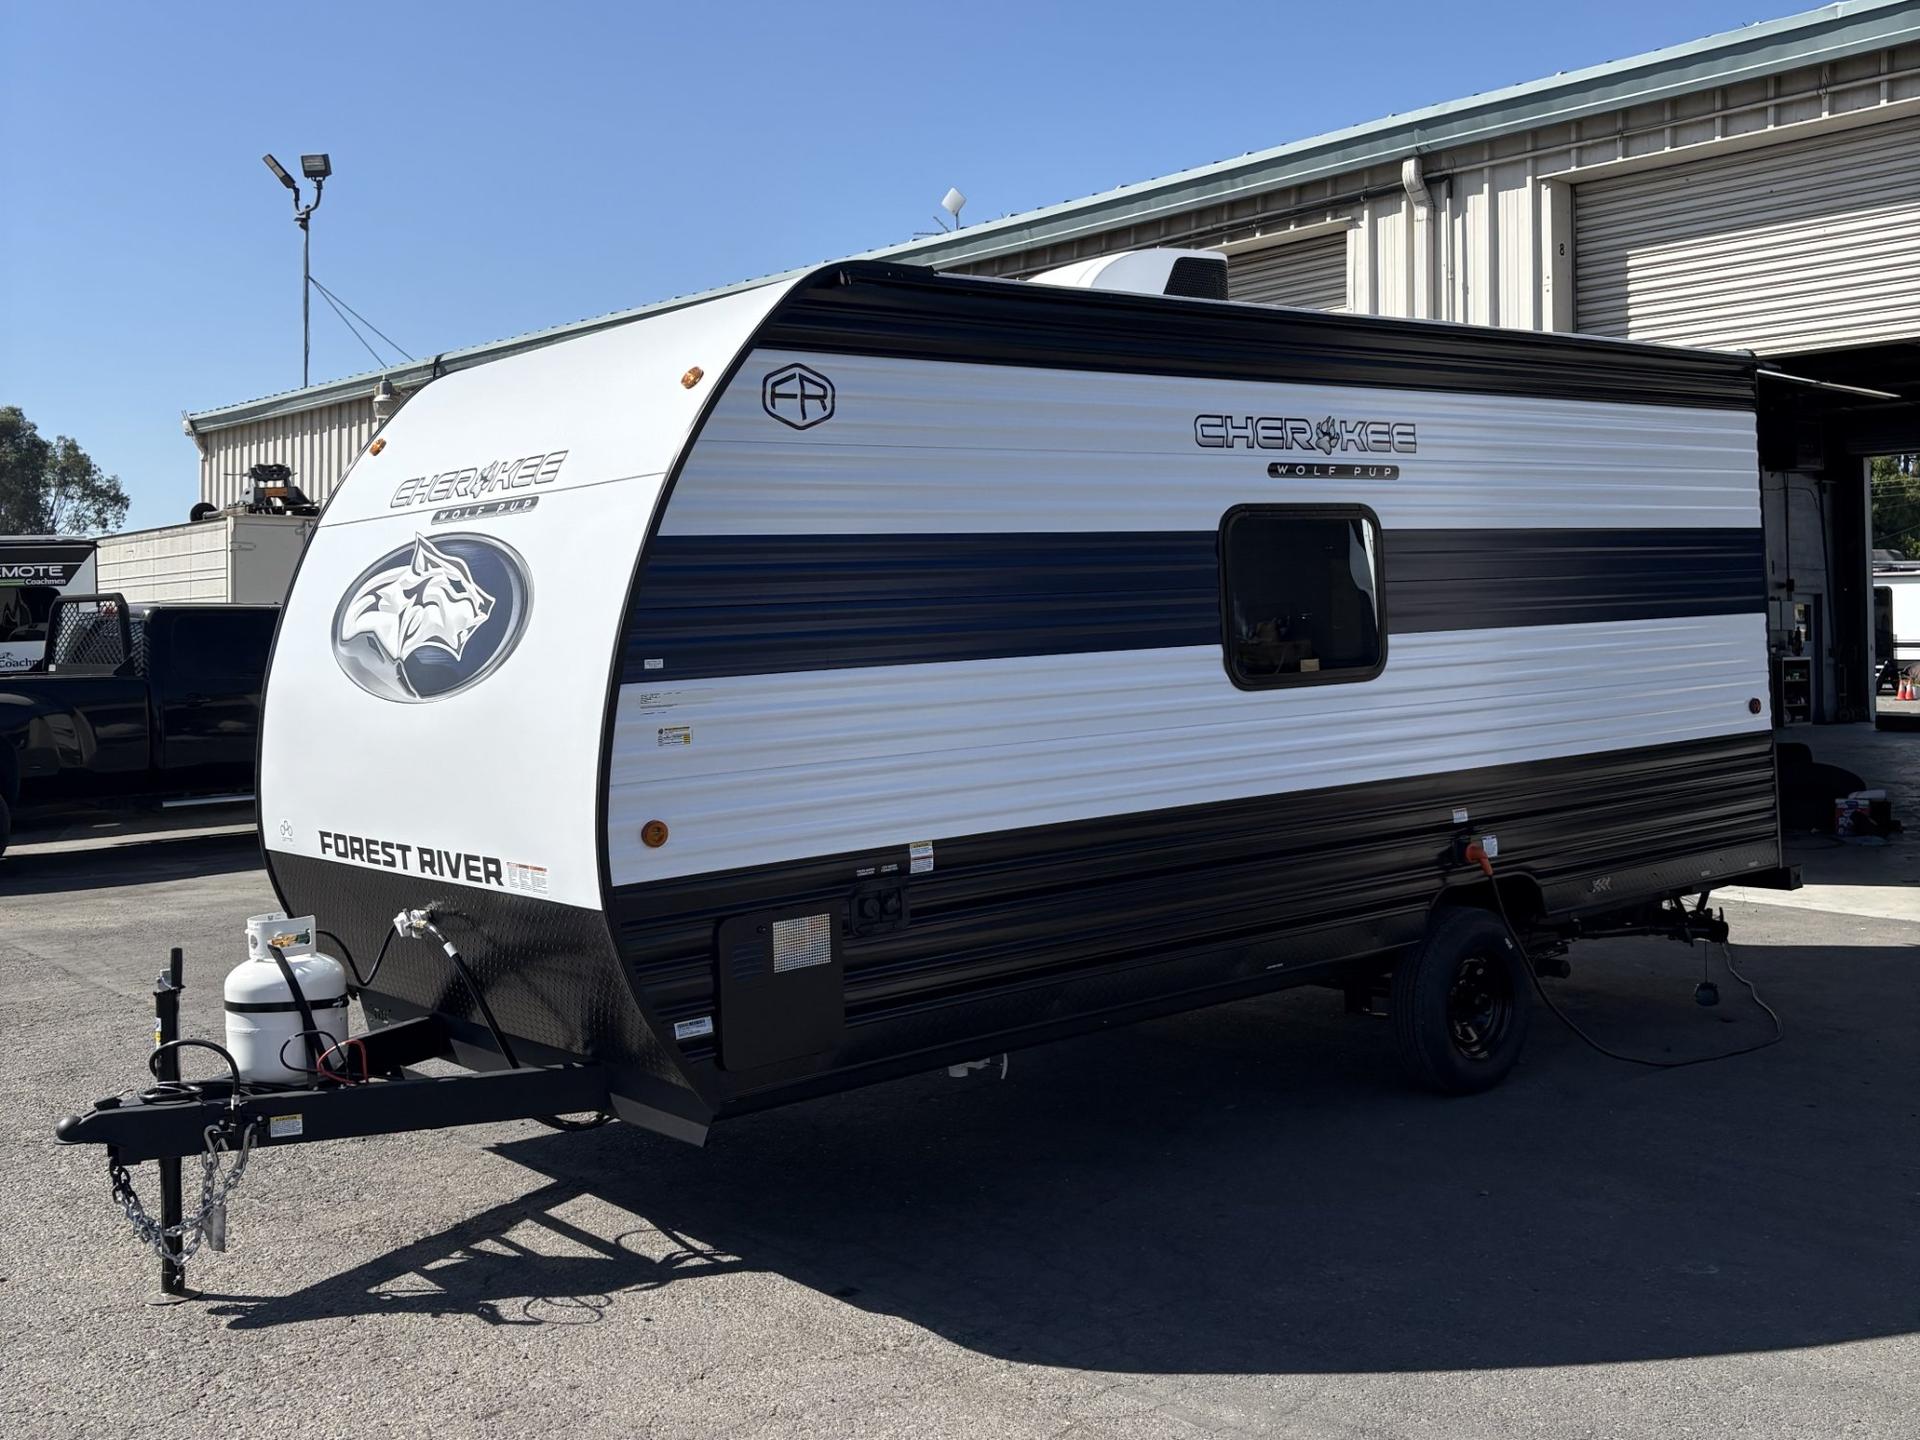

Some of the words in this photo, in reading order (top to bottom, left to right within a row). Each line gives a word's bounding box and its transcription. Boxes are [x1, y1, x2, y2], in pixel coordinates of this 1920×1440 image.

[1559, 242, 1565, 256] 8
[1276, 464, 1337, 476] WOLF
[1353, 466, 1393, 477] PUP
[438, 505, 485, 521] WOLF
[496, 498, 533, 513] PUP
[0, 565, 64, 578] MOTE
[318, 830, 412, 870] FOREST
[416, 846, 504, 887] RIVER
